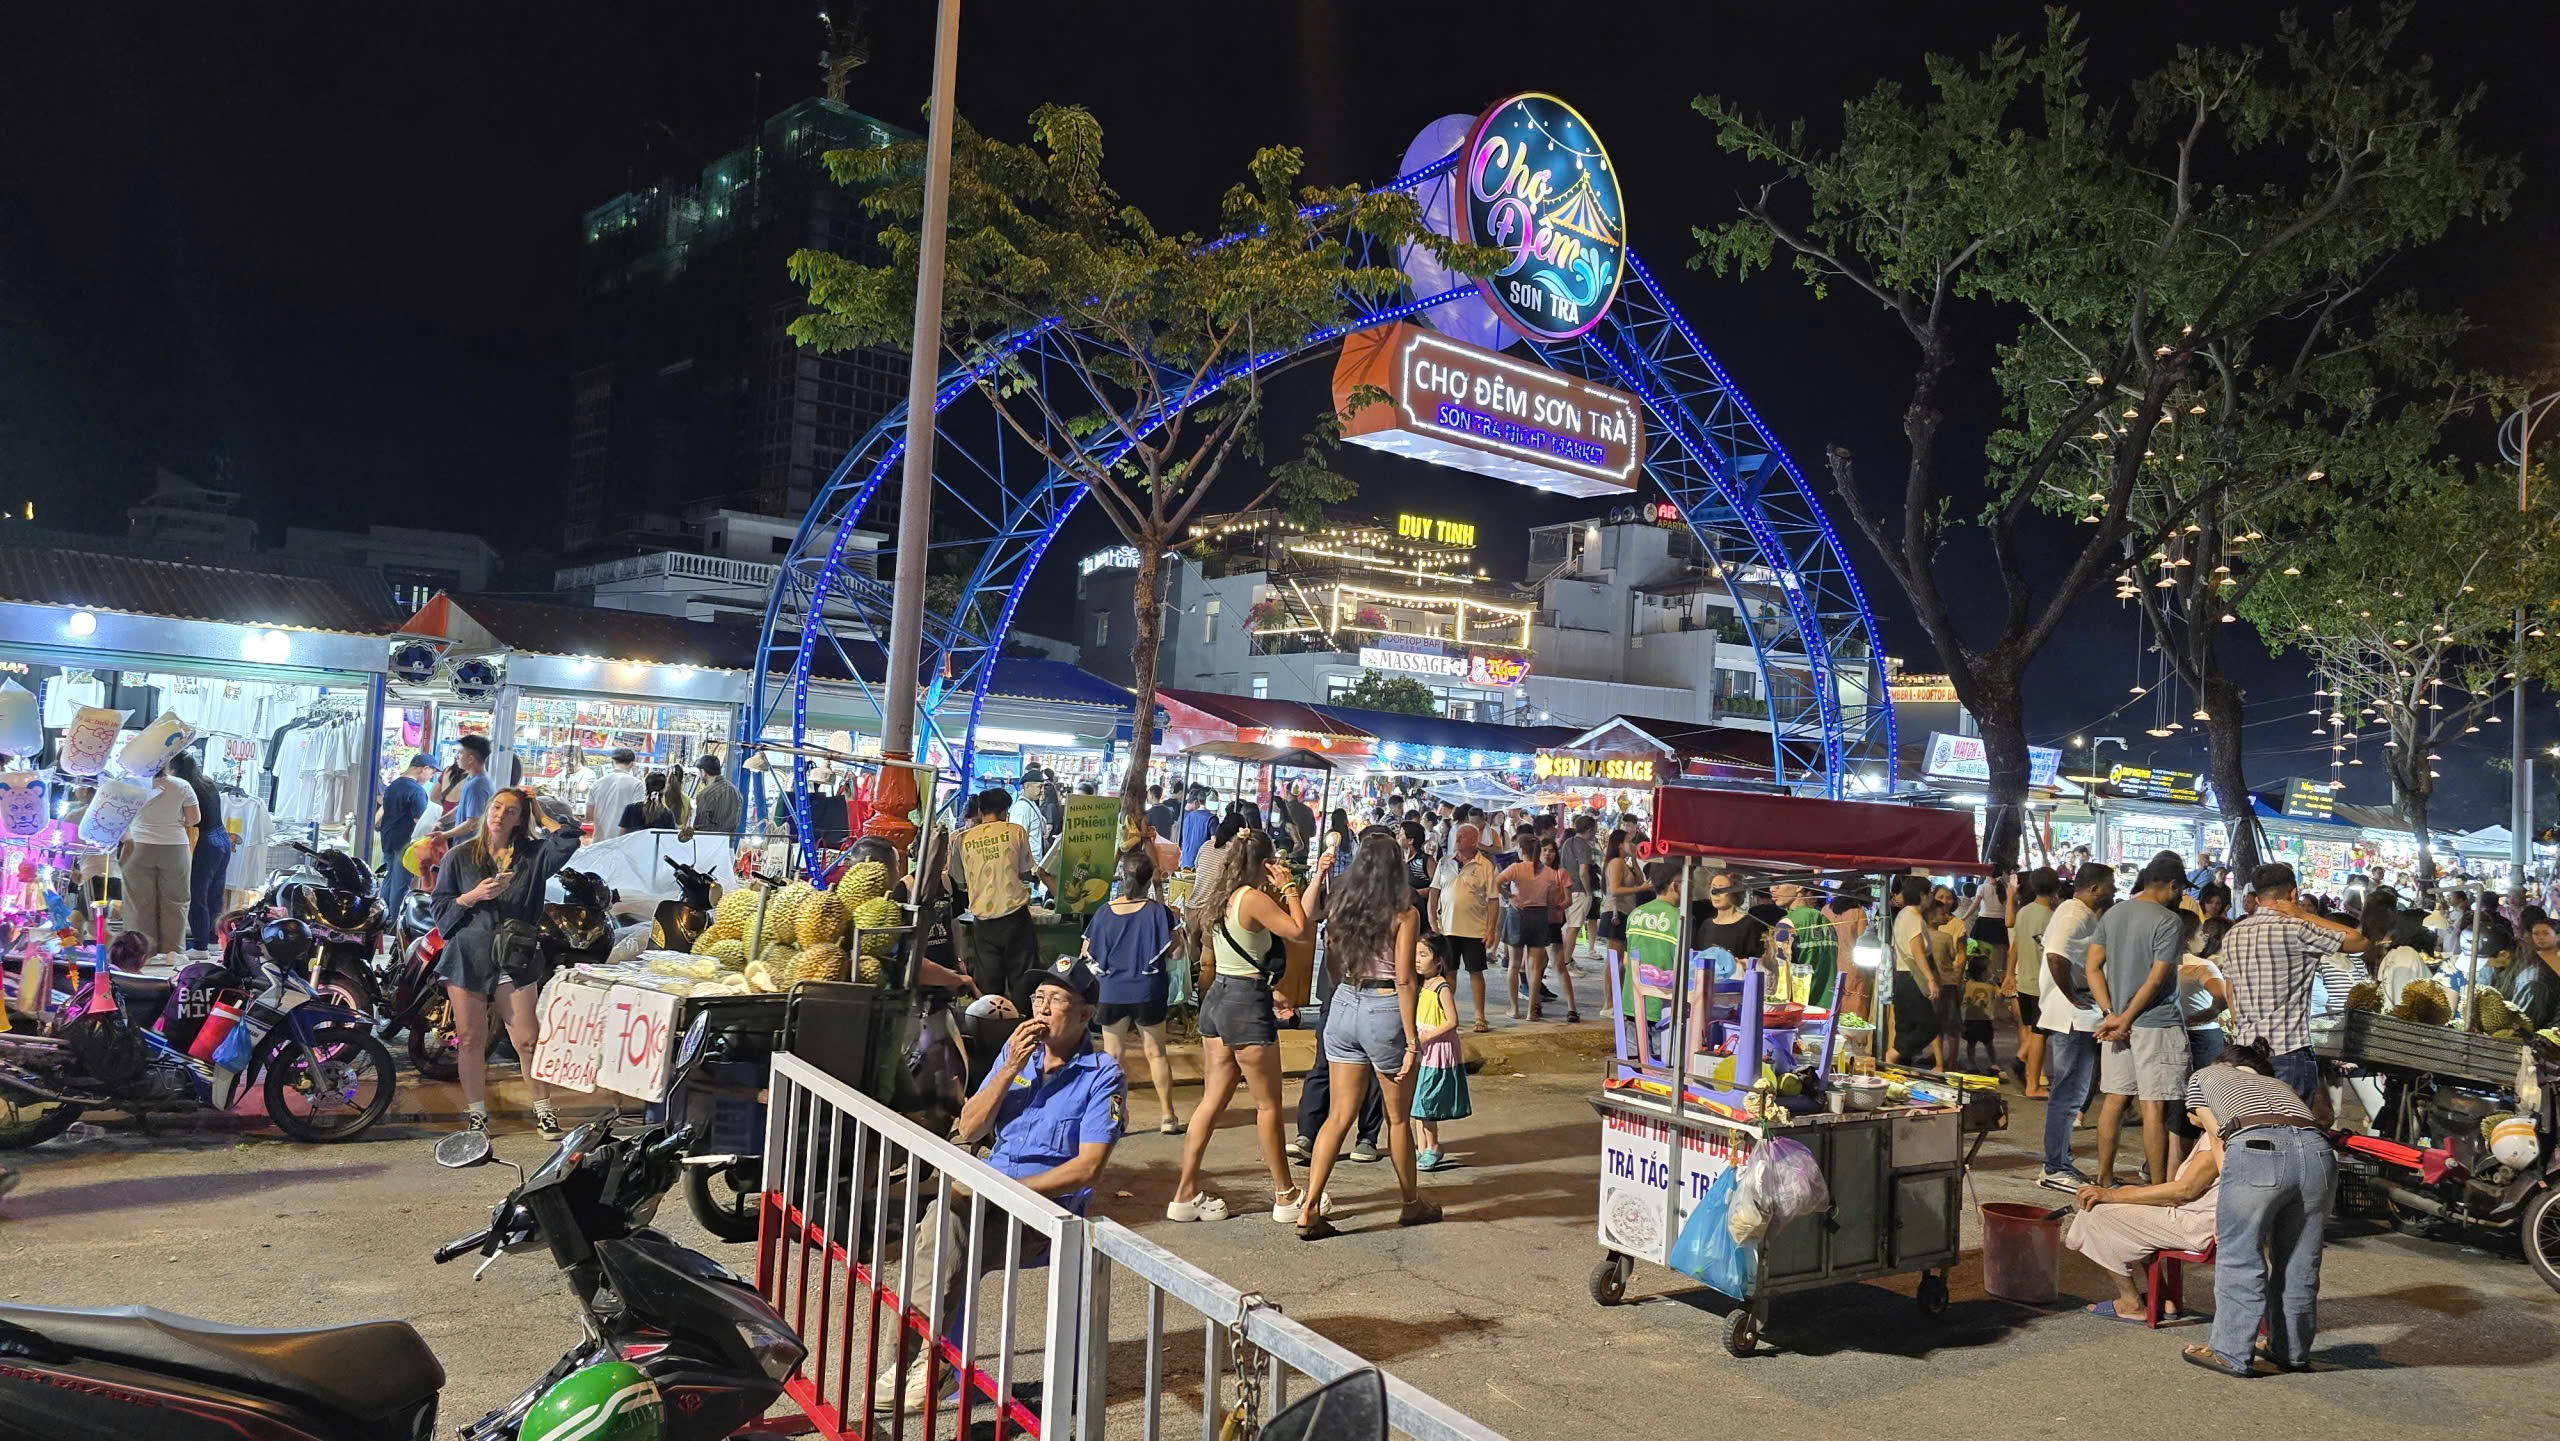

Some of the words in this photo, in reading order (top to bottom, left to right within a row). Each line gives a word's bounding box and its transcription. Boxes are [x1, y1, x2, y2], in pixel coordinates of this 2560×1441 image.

[1472, 136, 1553, 215] Chợ
[1487, 198, 1581, 277] Đêm
[1509, 280, 1543, 312] SƠN
[1415, 360, 1468, 405] CHỢ
[1474, 375, 1527, 419] ĐÊM
[1533, 394, 1582, 434] SƠN
[1587, 409, 1629, 445] TRÀ
[1399, 514, 1433, 540] DUY
[1436, 520, 1475, 546] TINH
[1424, 637, 1441, 649] BAR
[1379, 651, 1449, 674] MASSAGE
[1487, 658, 1522, 682] Tiger
[1947, 689, 1958, 701] BA
[226, 739, 256, 758] 90.000
[1953, 740, 1979, 759] WATCH
[1553, 757, 1581, 777] SEN
[1583, 759, 1654, 782] MASSAGE
[1629, 908, 1672, 933] Grab
[1607, 1147, 1635, 1181] TRÀ
[1640, 1150, 1669, 1190] TẮC
